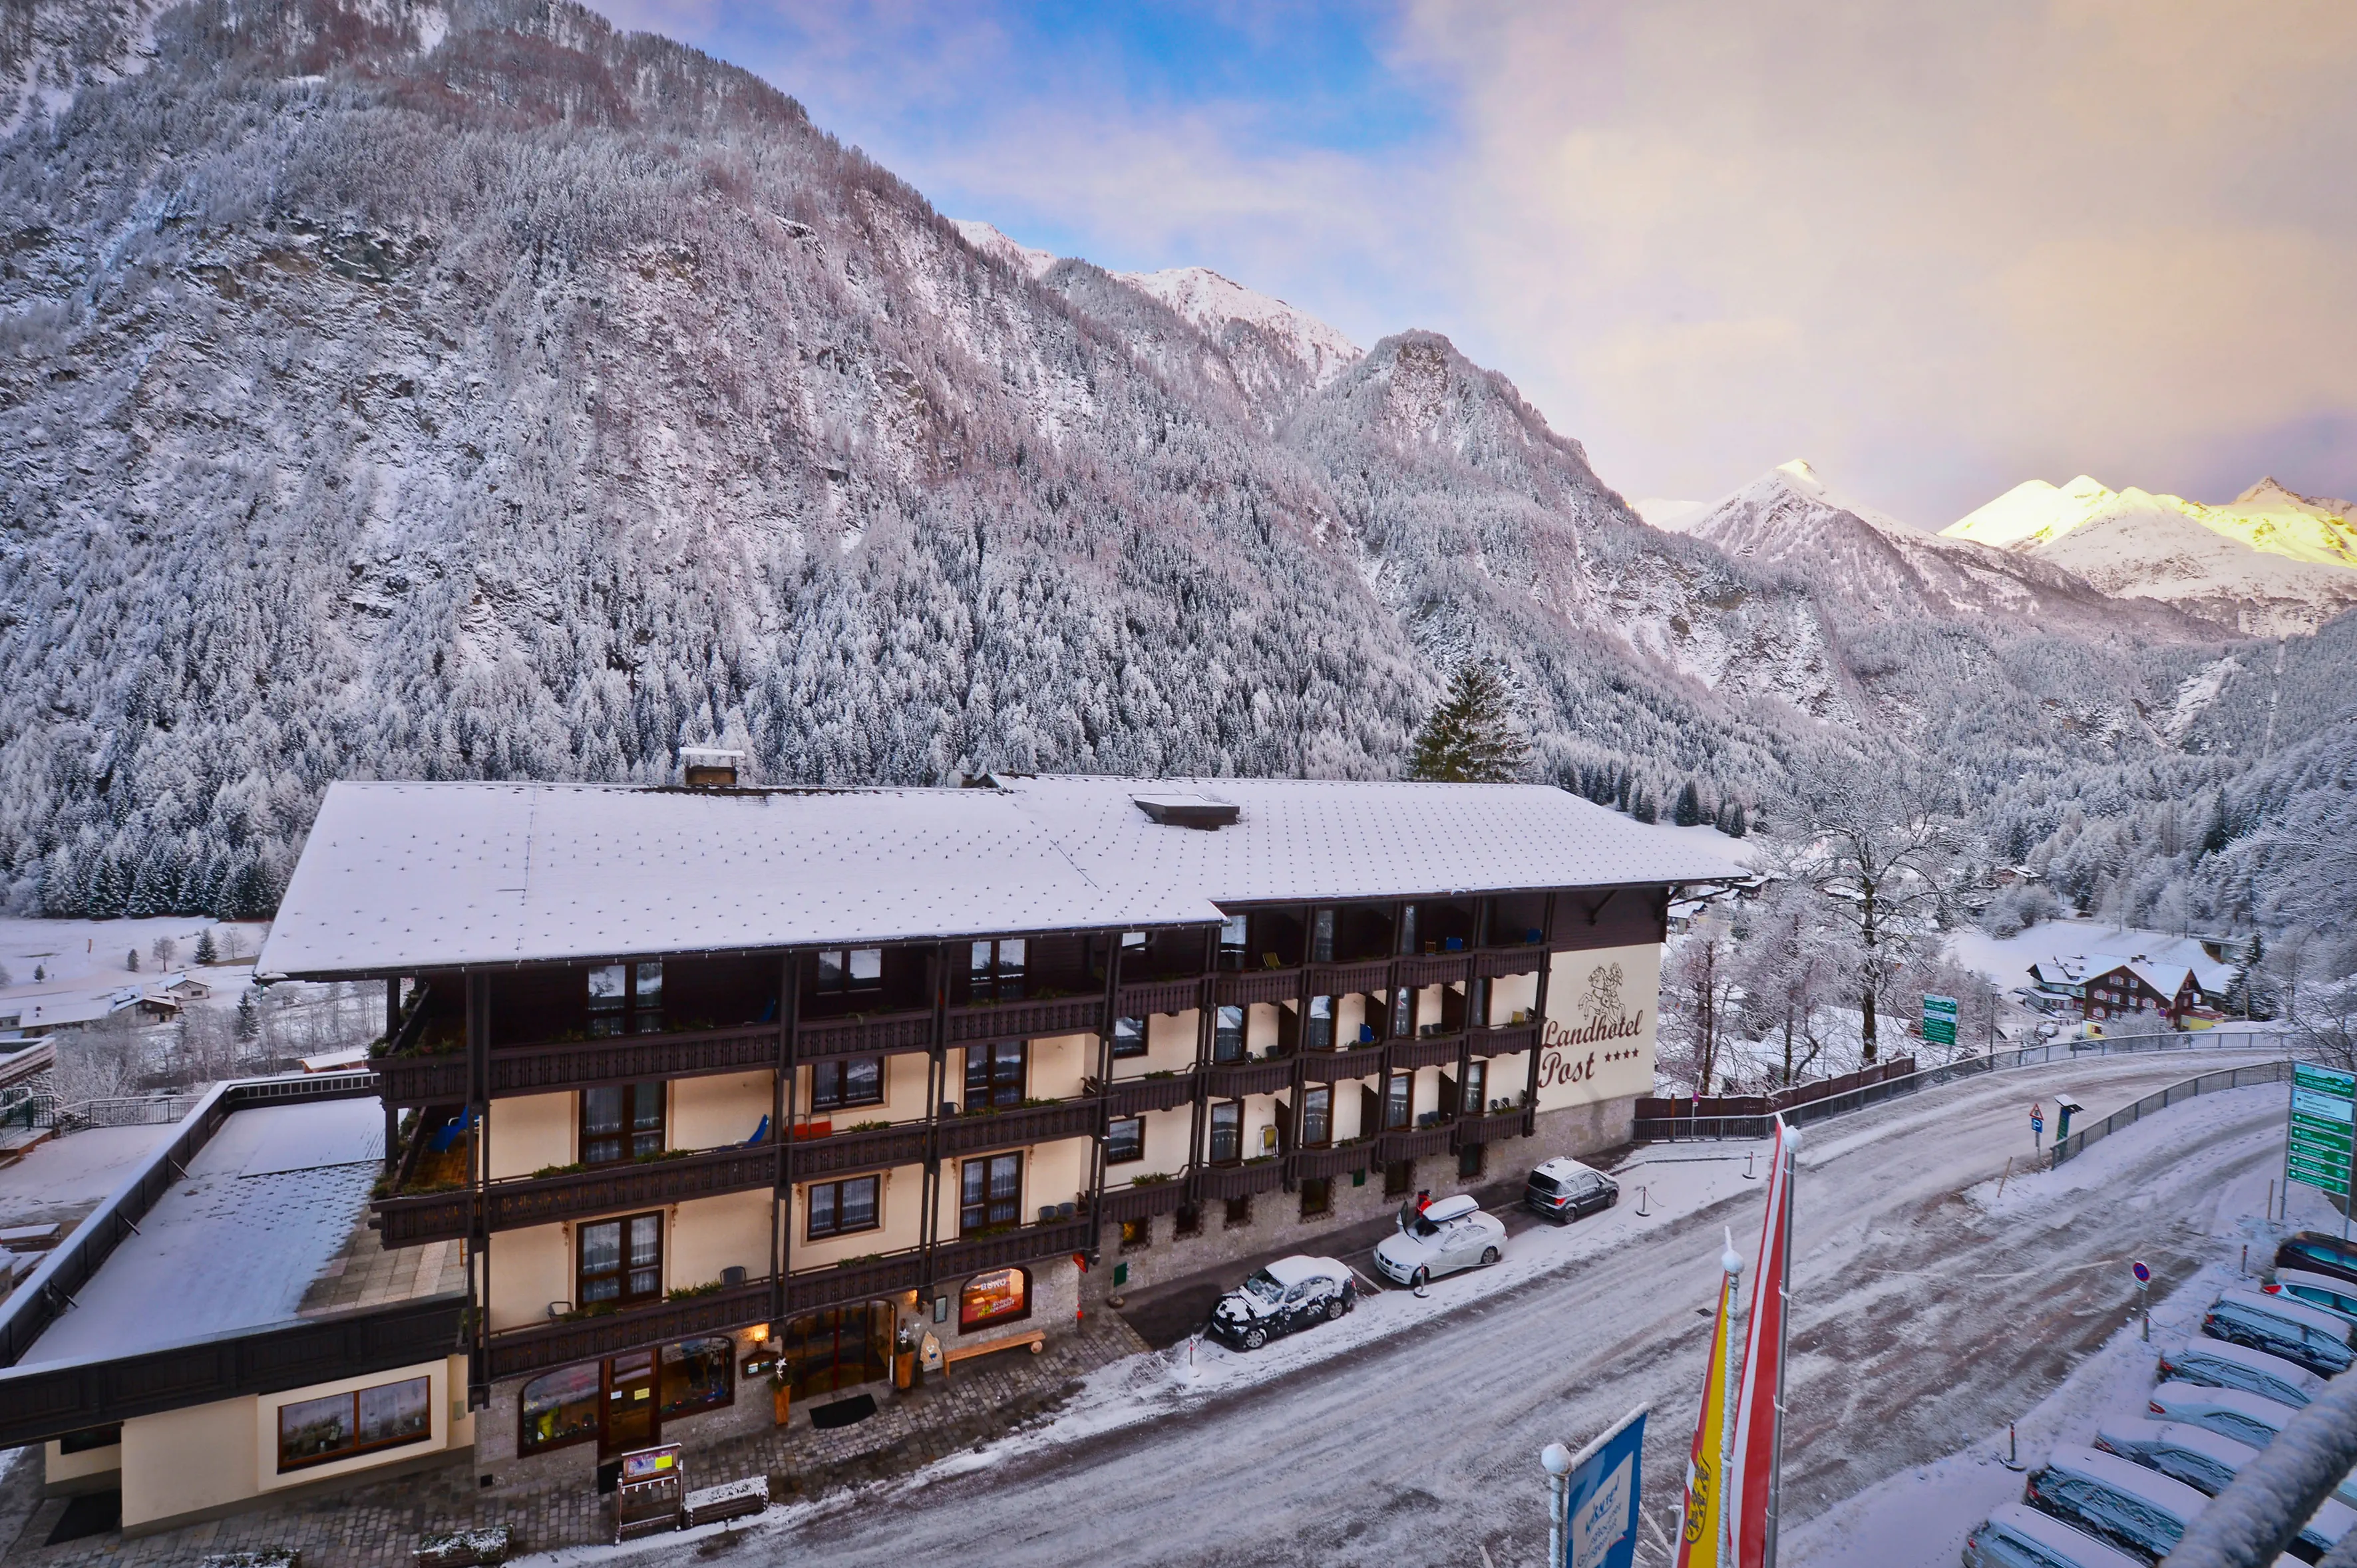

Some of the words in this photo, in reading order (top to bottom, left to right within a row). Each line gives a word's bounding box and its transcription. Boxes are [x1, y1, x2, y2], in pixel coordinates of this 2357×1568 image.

[1542, 1009, 1644, 1049] Landhotel
[1538, 1050, 1595, 1088] Post
[2032, 1119, 2041, 1130] P
